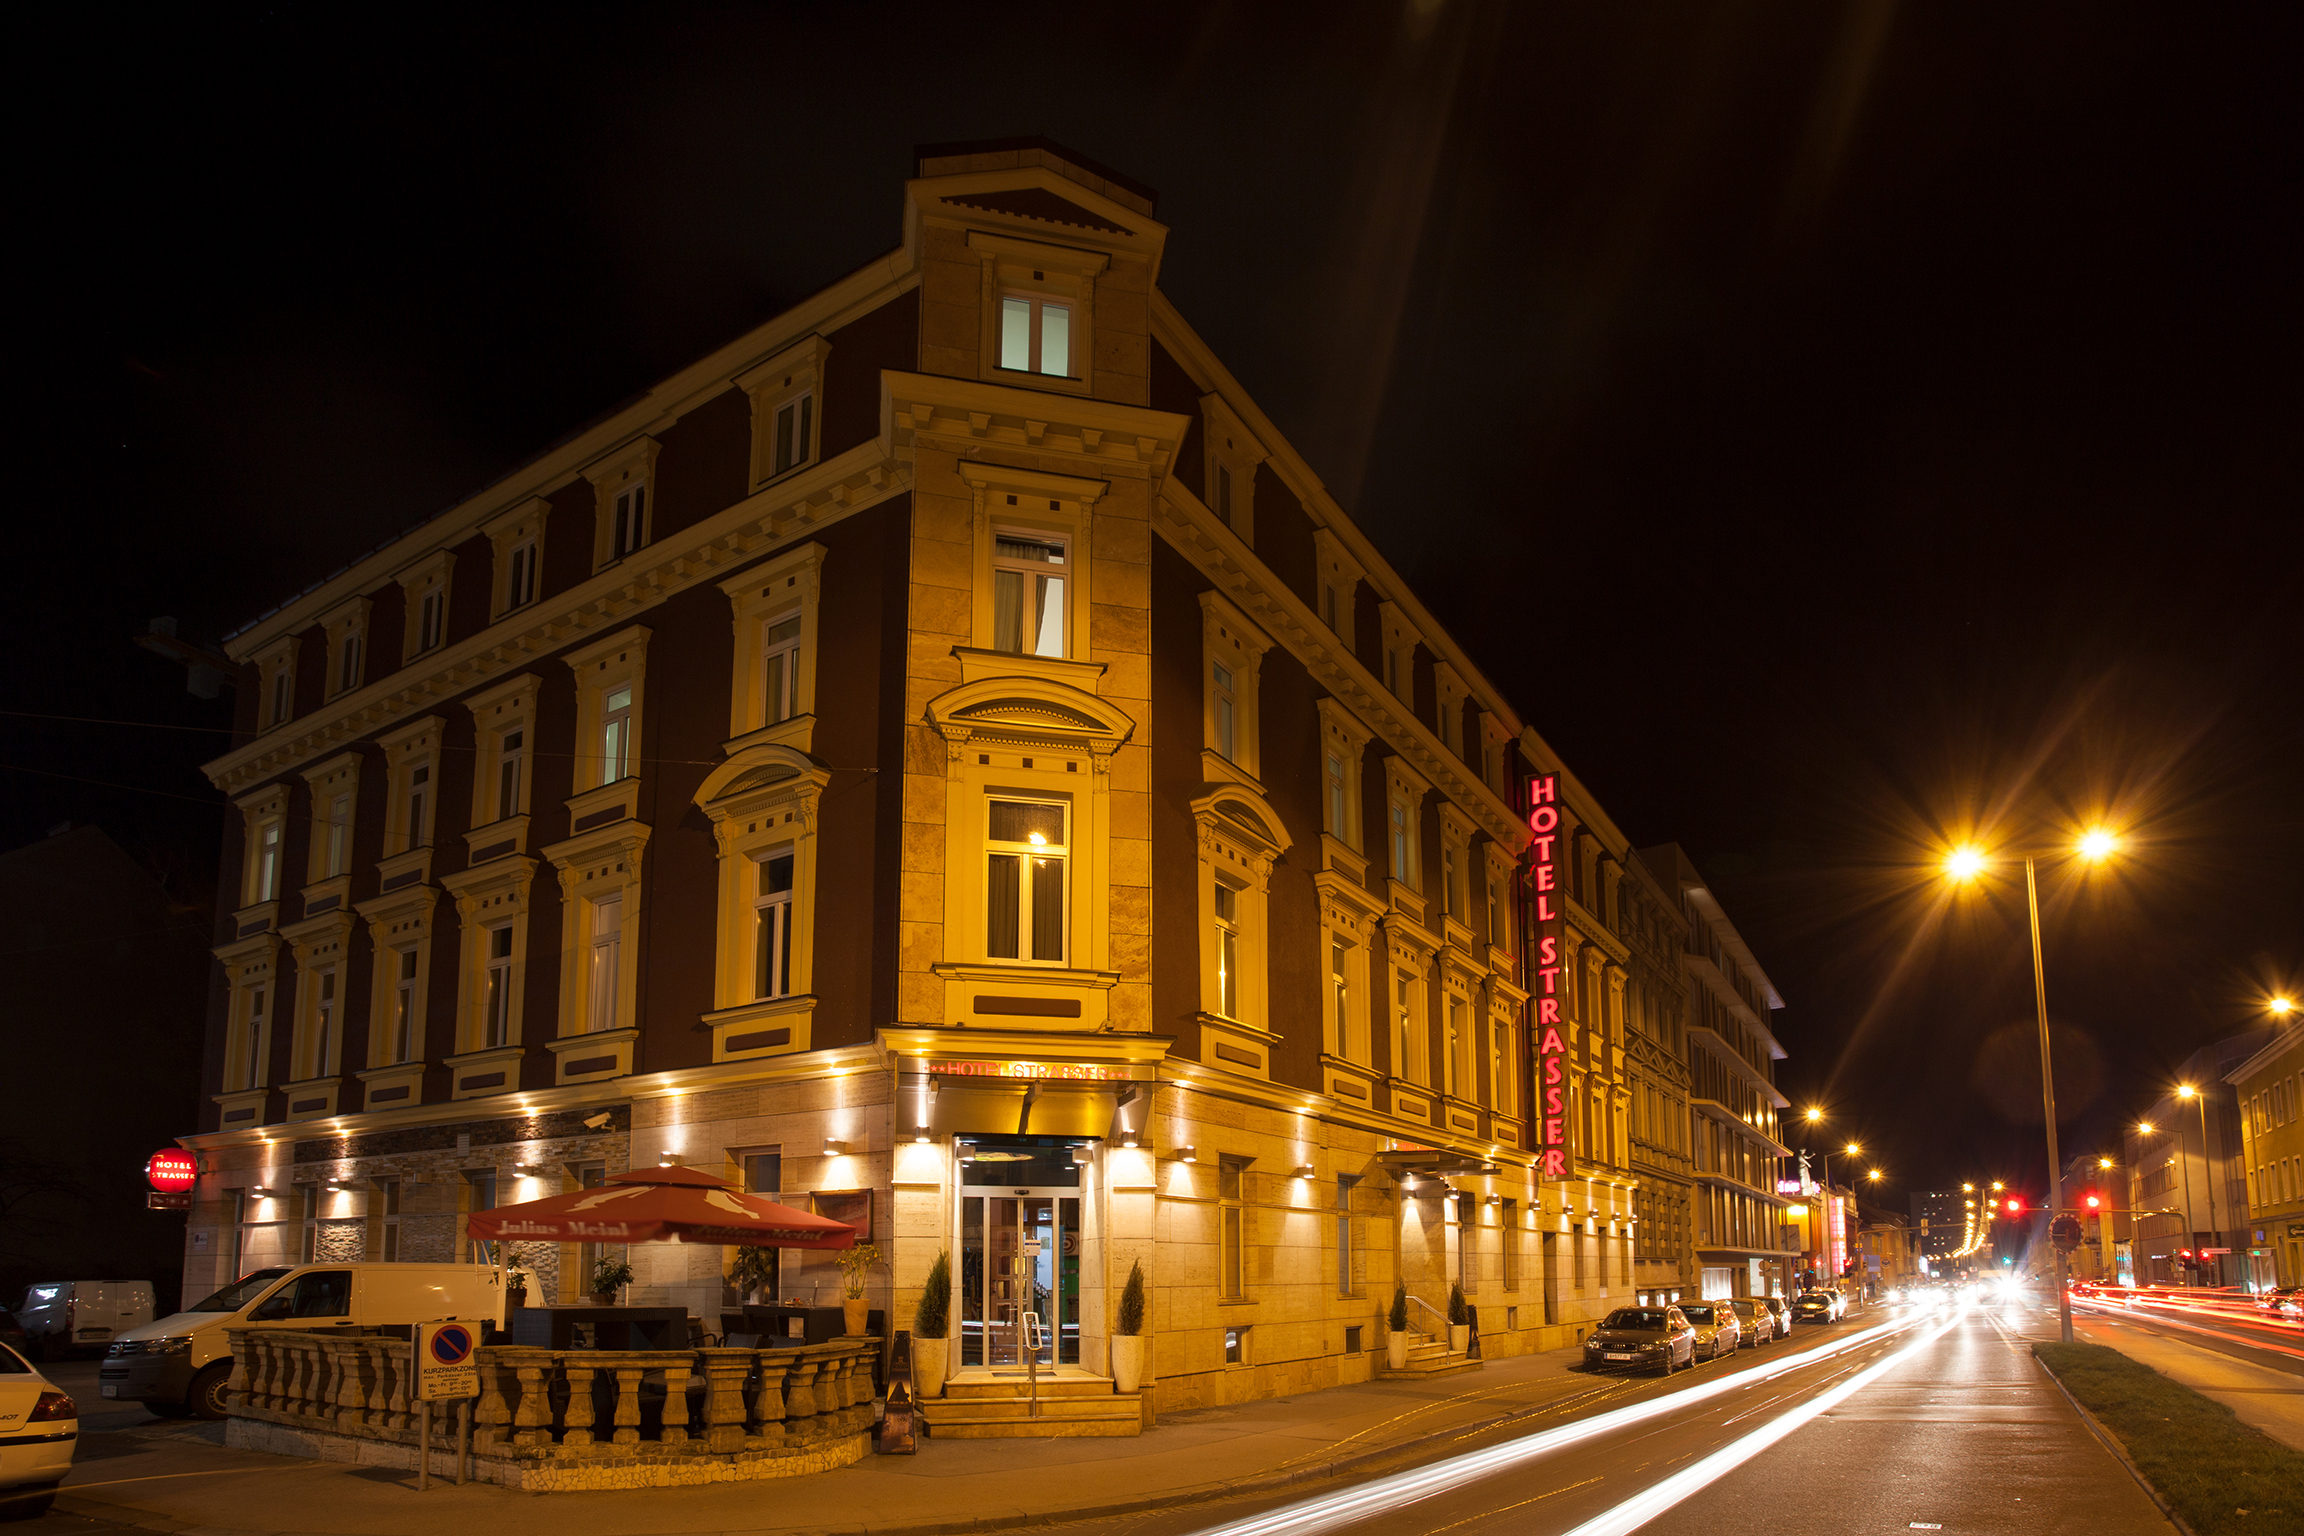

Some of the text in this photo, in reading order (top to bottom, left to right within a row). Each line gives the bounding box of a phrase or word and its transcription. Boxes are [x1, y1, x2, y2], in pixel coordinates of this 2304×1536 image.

[1530, 776, 1568, 1176] HOTEL STRASSER
[947, 1061, 1108, 1080] HOTEL STRASSER
[151, 1161, 196, 1180] HOTEL STRASSER
[496, 1219, 630, 1237] Julius Meinl
[424, 1364, 478, 1374] KURZPARKZONE
